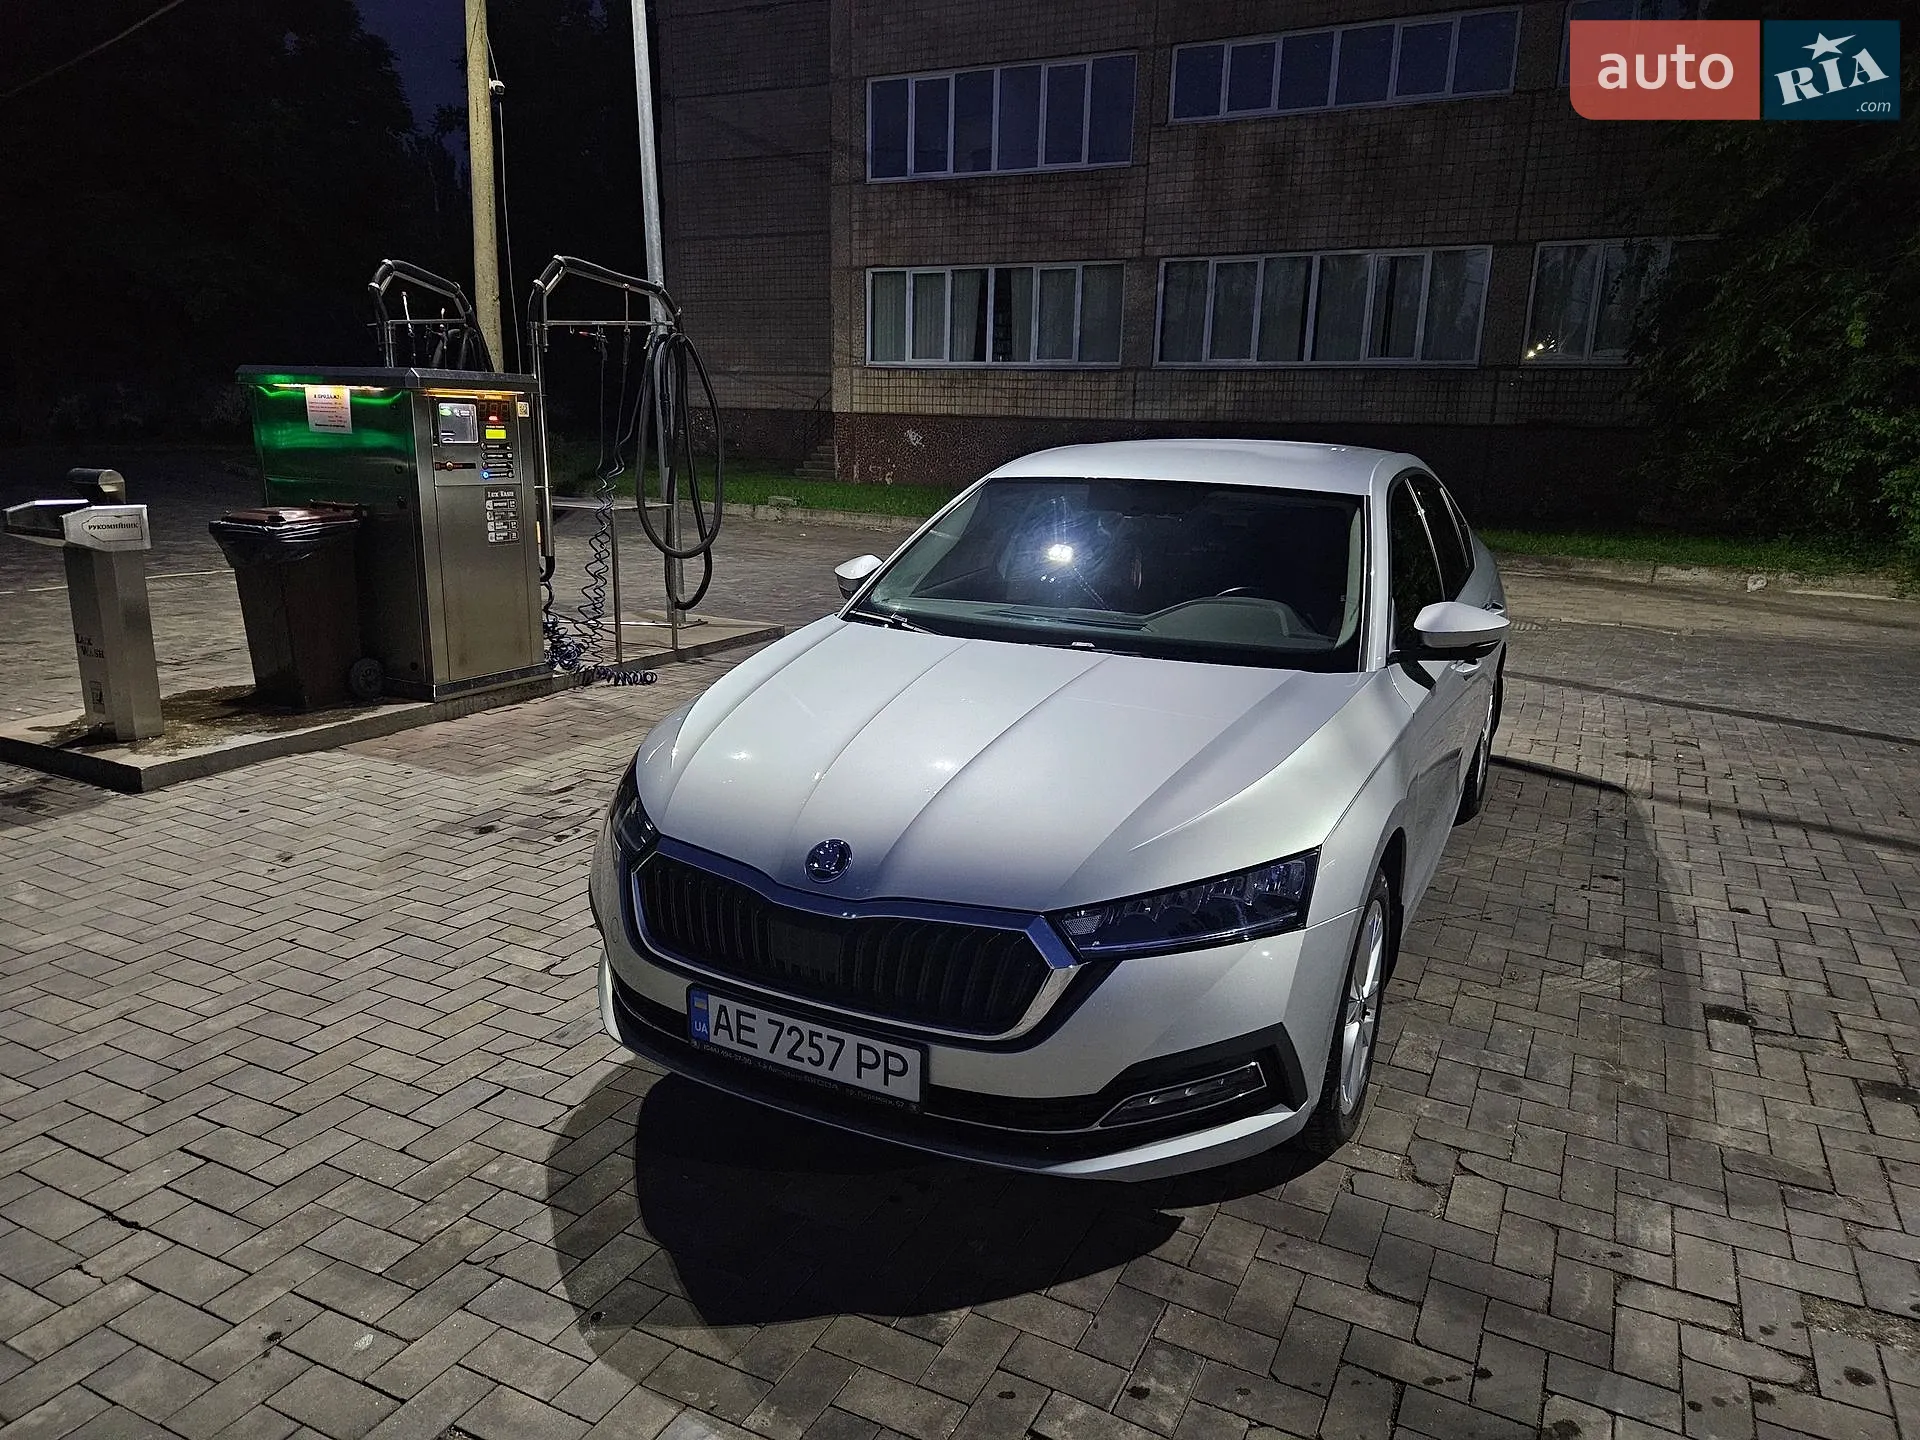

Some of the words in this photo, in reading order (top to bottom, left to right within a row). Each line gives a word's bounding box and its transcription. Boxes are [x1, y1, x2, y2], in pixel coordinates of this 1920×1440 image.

[88, 522, 140, 531] РУКОМИЙНИК
[694, 1021, 709, 1035] UA
[713, 1004, 758, 1050] AE
[767, 1018, 846, 1072] 7257
[856, 1042, 909, 1087] PP
